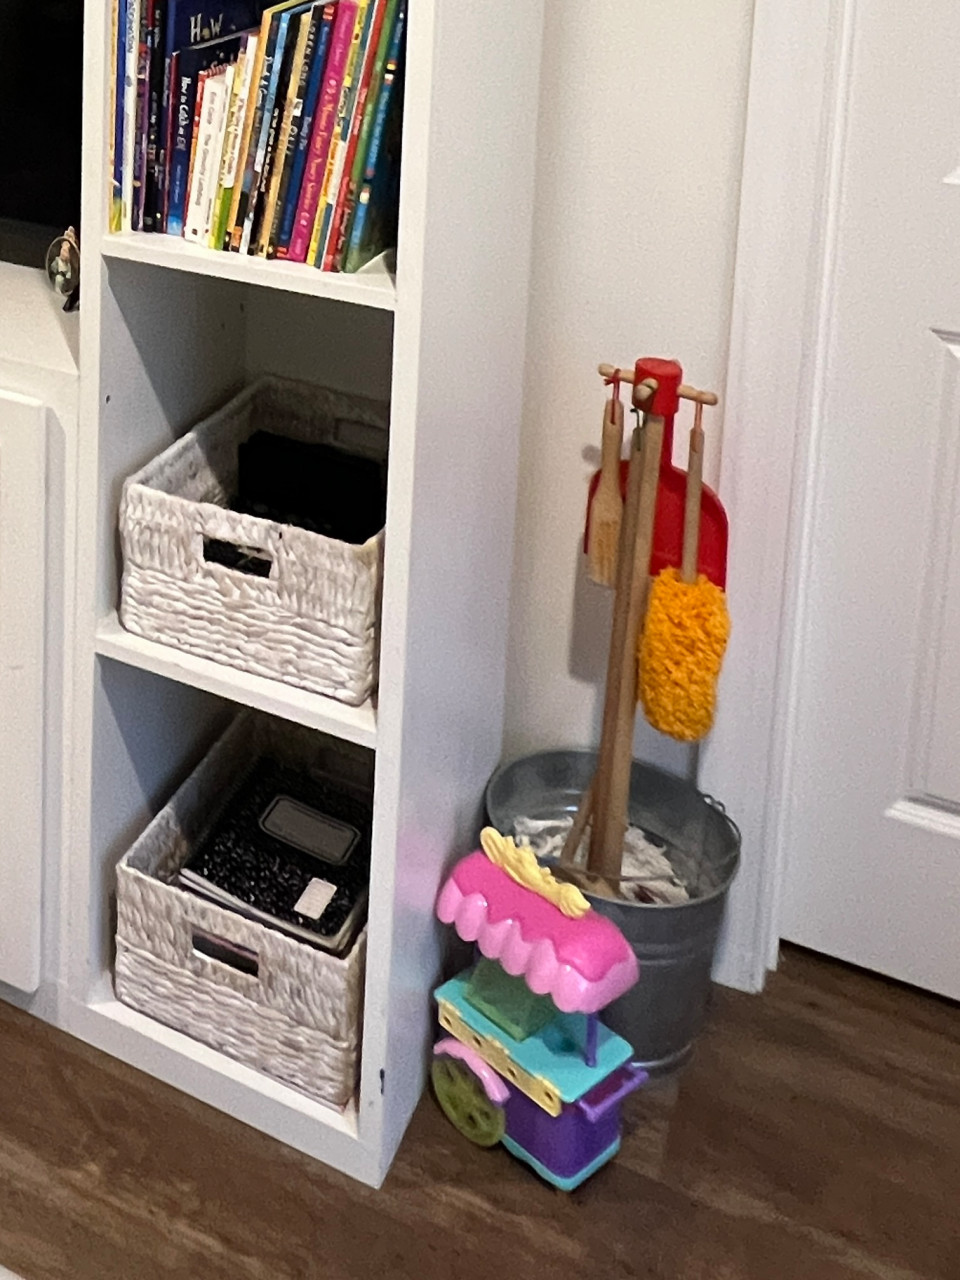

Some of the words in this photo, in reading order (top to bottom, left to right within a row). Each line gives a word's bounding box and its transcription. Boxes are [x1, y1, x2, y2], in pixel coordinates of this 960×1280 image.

[180, 76, 191, 93] How
[177, 104, 190, 126] Catch
[205, 106, 215, 125] Carle
[203, 133, 211, 146] The
